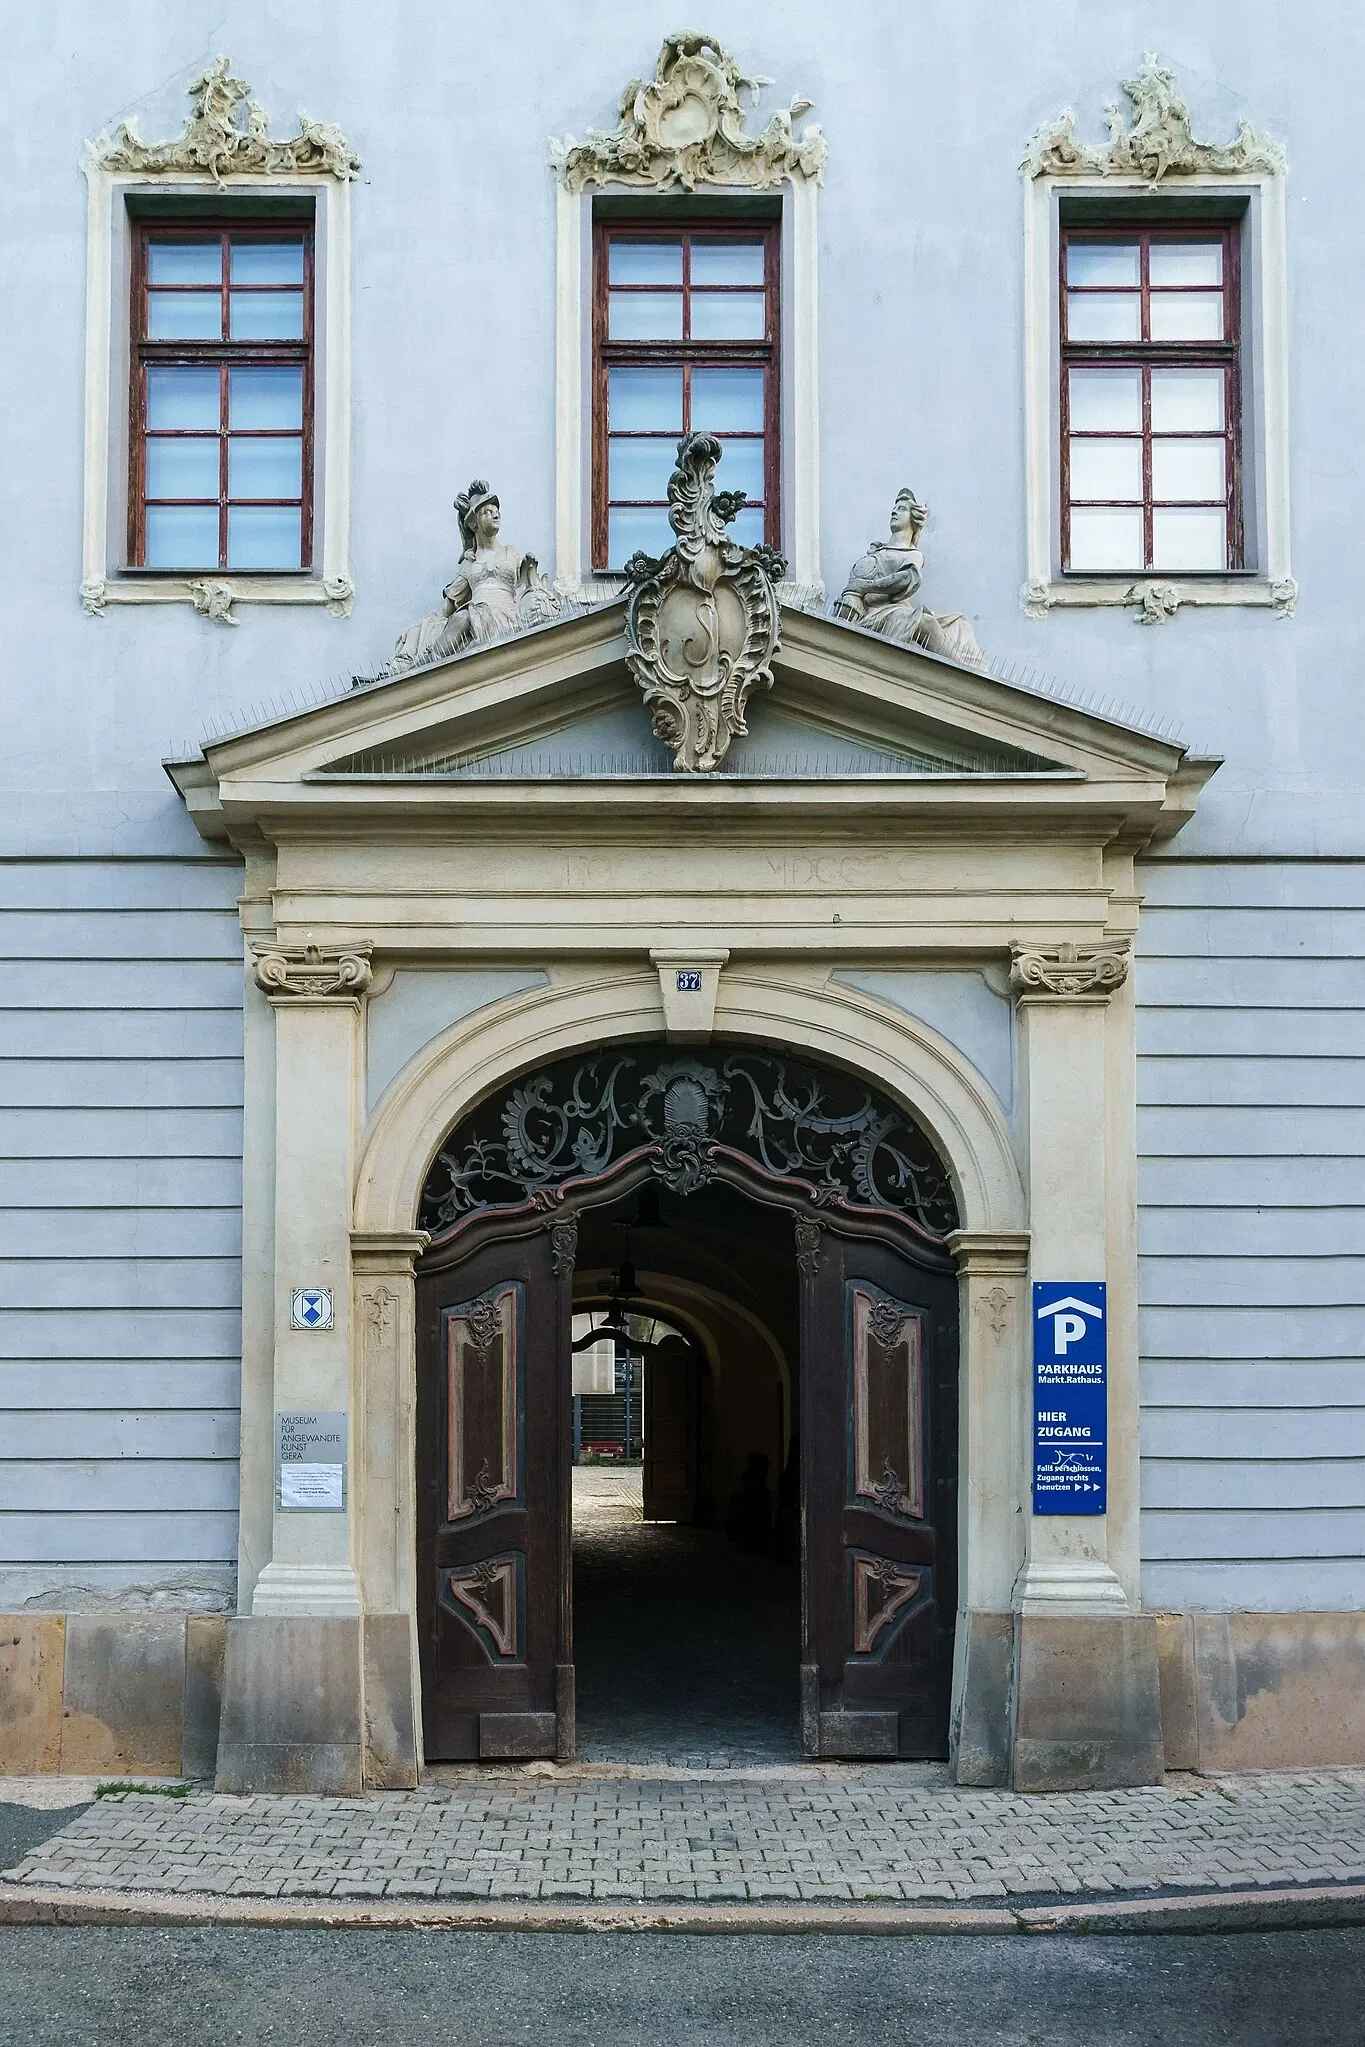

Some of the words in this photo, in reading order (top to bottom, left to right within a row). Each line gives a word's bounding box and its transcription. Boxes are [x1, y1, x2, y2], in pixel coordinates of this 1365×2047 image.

[679, 973, 698, 988] 37
[1054, 1314, 1087, 1355] P
[1038, 1364, 1103, 1374] PARKHAUS
[1038, 1412, 1067, 1422] HIER
[281, 1425, 295, 1433] FÜR
[1038, 1427, 1091, 1437] ZUGANG
[281, 1452, 303, 1460] GERA
[1055, 1465, 1102, 1473] verschlossen,
[1037, 1474, 1065, 1482] Zugang
[1066, 1474, 1089, 1482] rechts
[1037, 1483, 1071, 1491] benutzen
